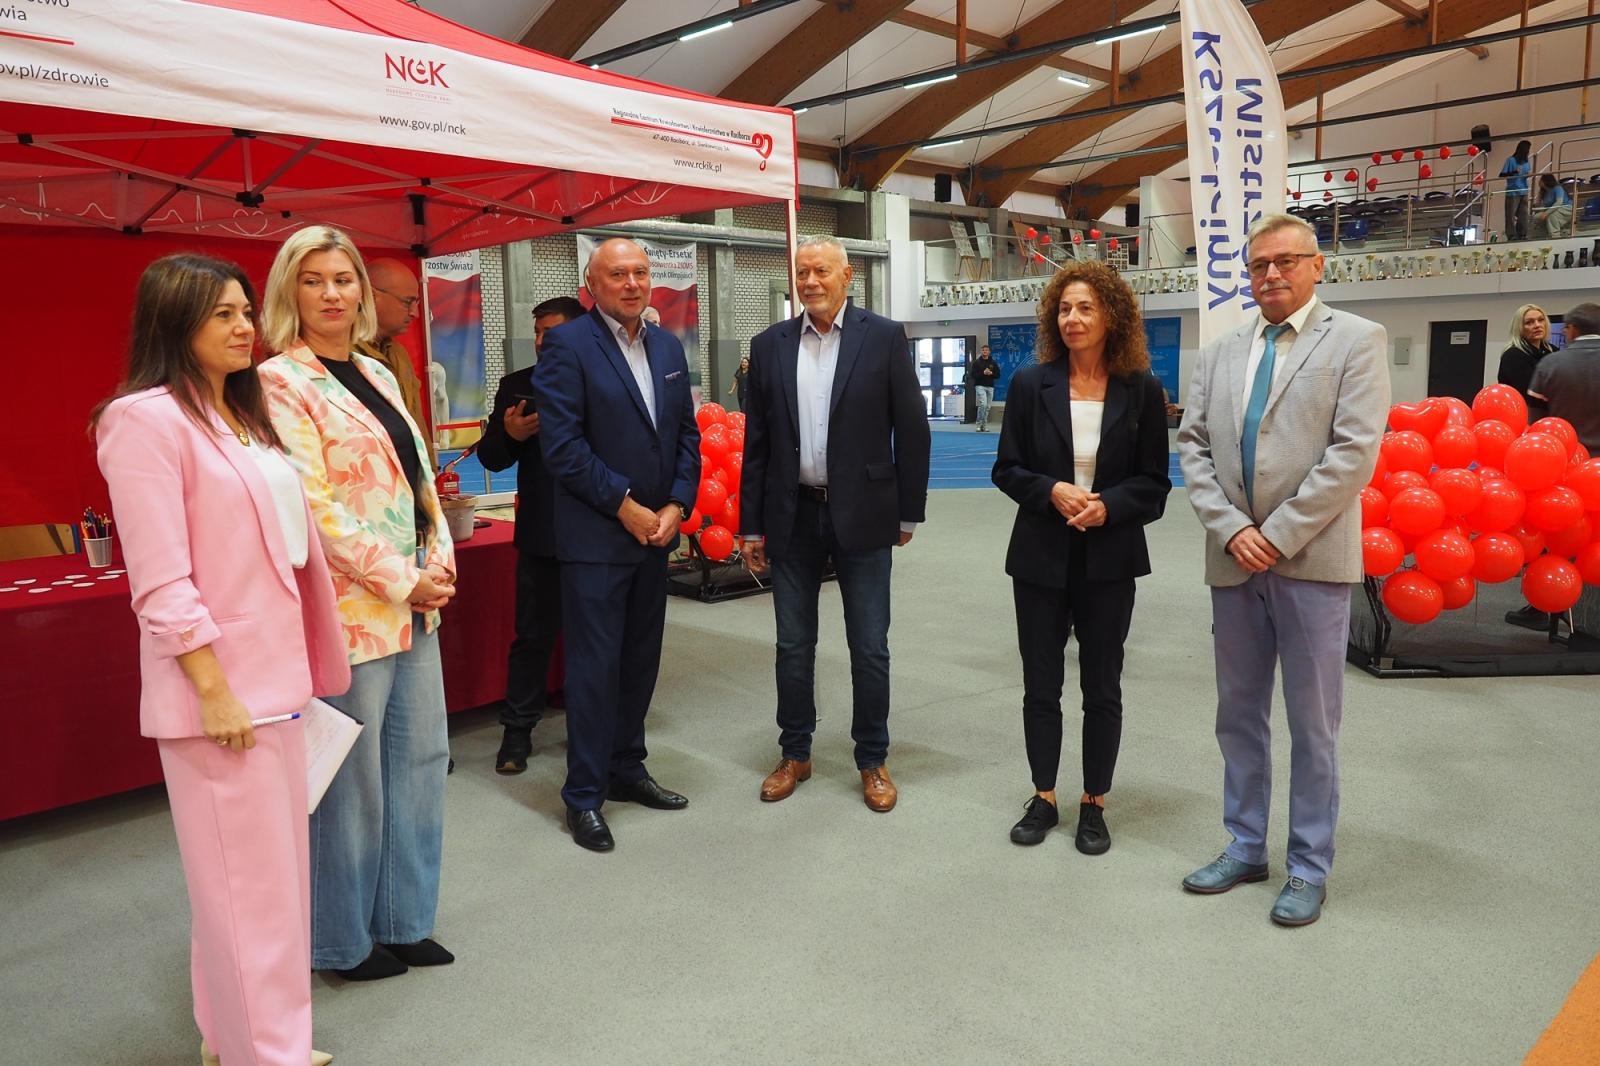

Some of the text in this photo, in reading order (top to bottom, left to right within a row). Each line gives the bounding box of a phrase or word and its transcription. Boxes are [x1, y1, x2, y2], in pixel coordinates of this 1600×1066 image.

[384, 52, 450, 88] NCK
[379, 115, 466, 135] www.gov.pl/nck
[674, 157, 722, 173] www.rckik.pl
[450, 259, 474, 271] Świata
